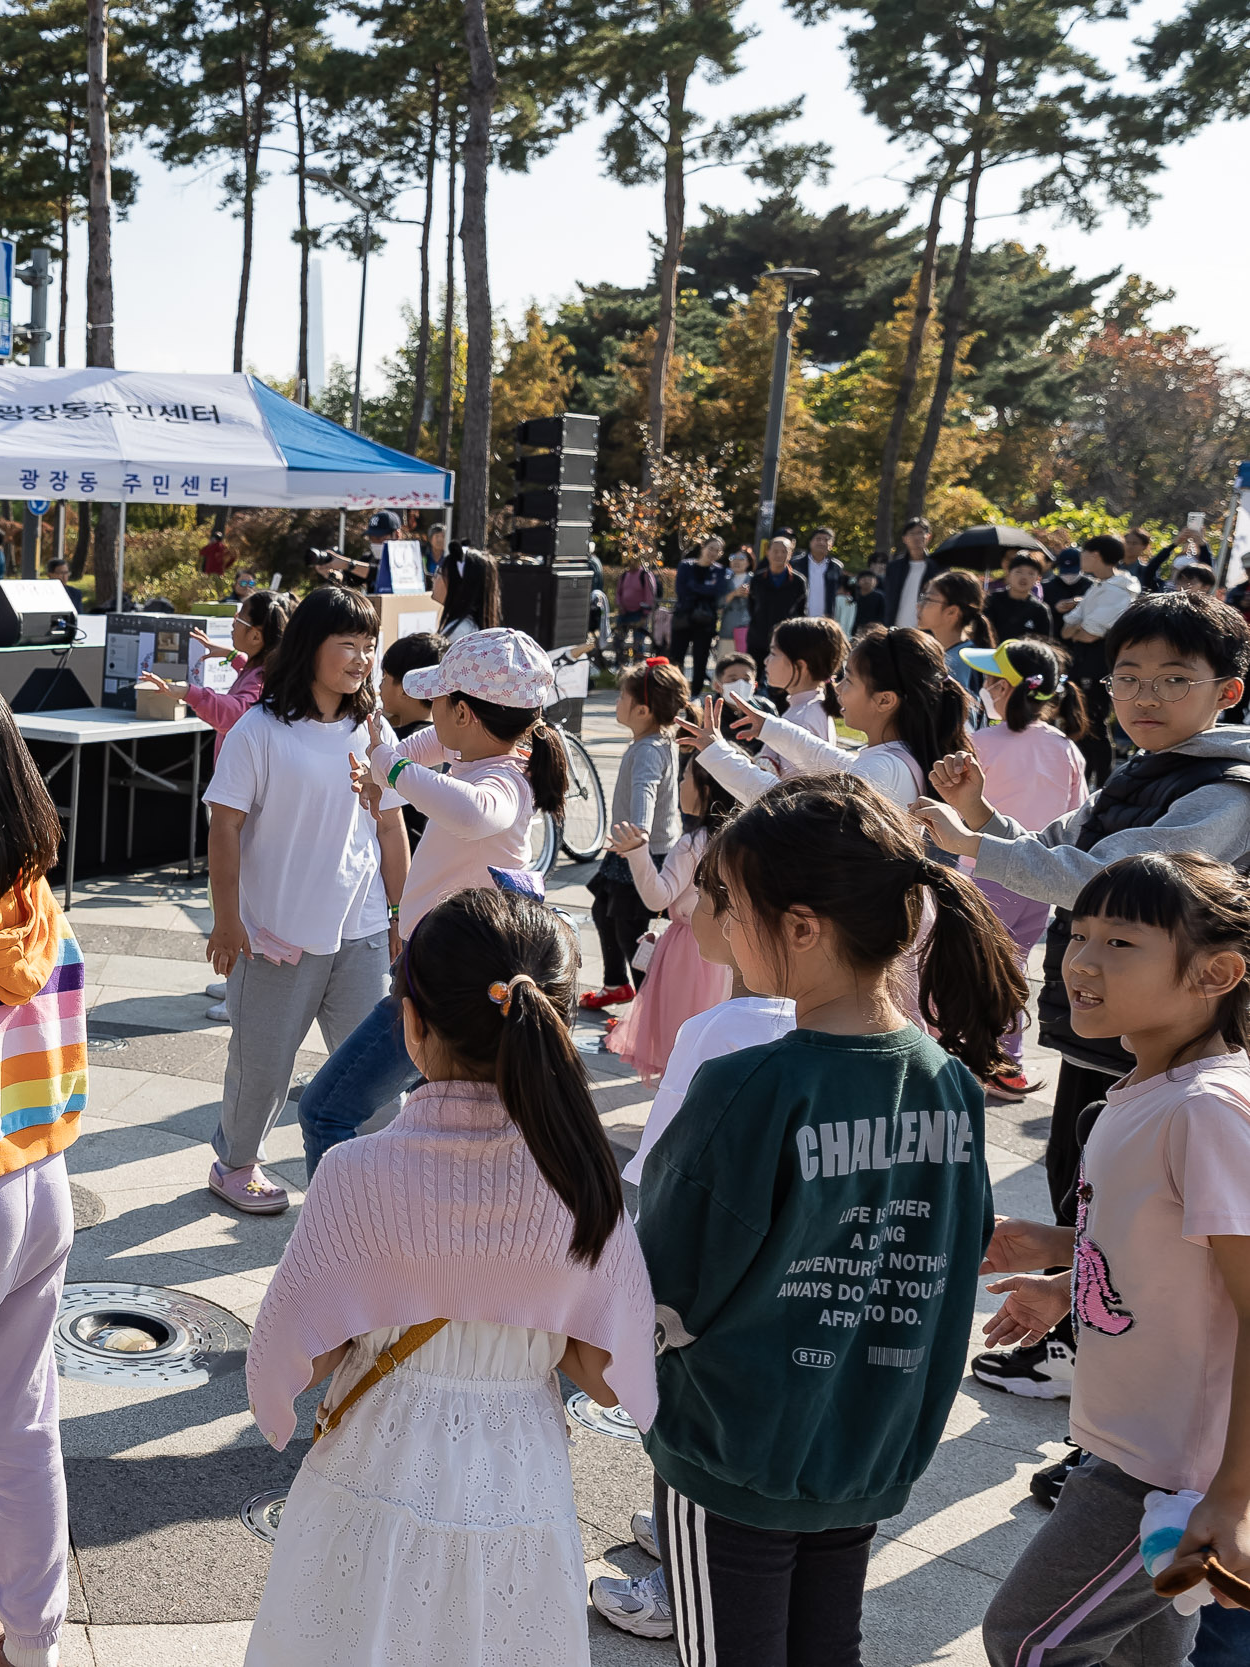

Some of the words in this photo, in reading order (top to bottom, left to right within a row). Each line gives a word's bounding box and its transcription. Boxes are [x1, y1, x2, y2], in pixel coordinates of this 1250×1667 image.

[19, 469, 98, 493] 광장동
[122, 473, 229, 498] 주민센터
[838, 1206, 871, 1225] LIFE
[875, 1207, 887, 1224] IS
[888, 1199, 931, 1219] THER
[850, 1233, 864, 1250] A
[785, 1256, 878, 1277] ADVENTURE
[838, 1283, 864, 1302] DO
[870, 1278, 892, 1295] AT
[895, 1279, 932, 1300] YOU
[819, 1309, 861, 1328] AFRA
[864, 1304, 885, 1322] TO
[891, 1306, 922, 1326] DO.
[799, 1351, 831, 1365] BTJR
